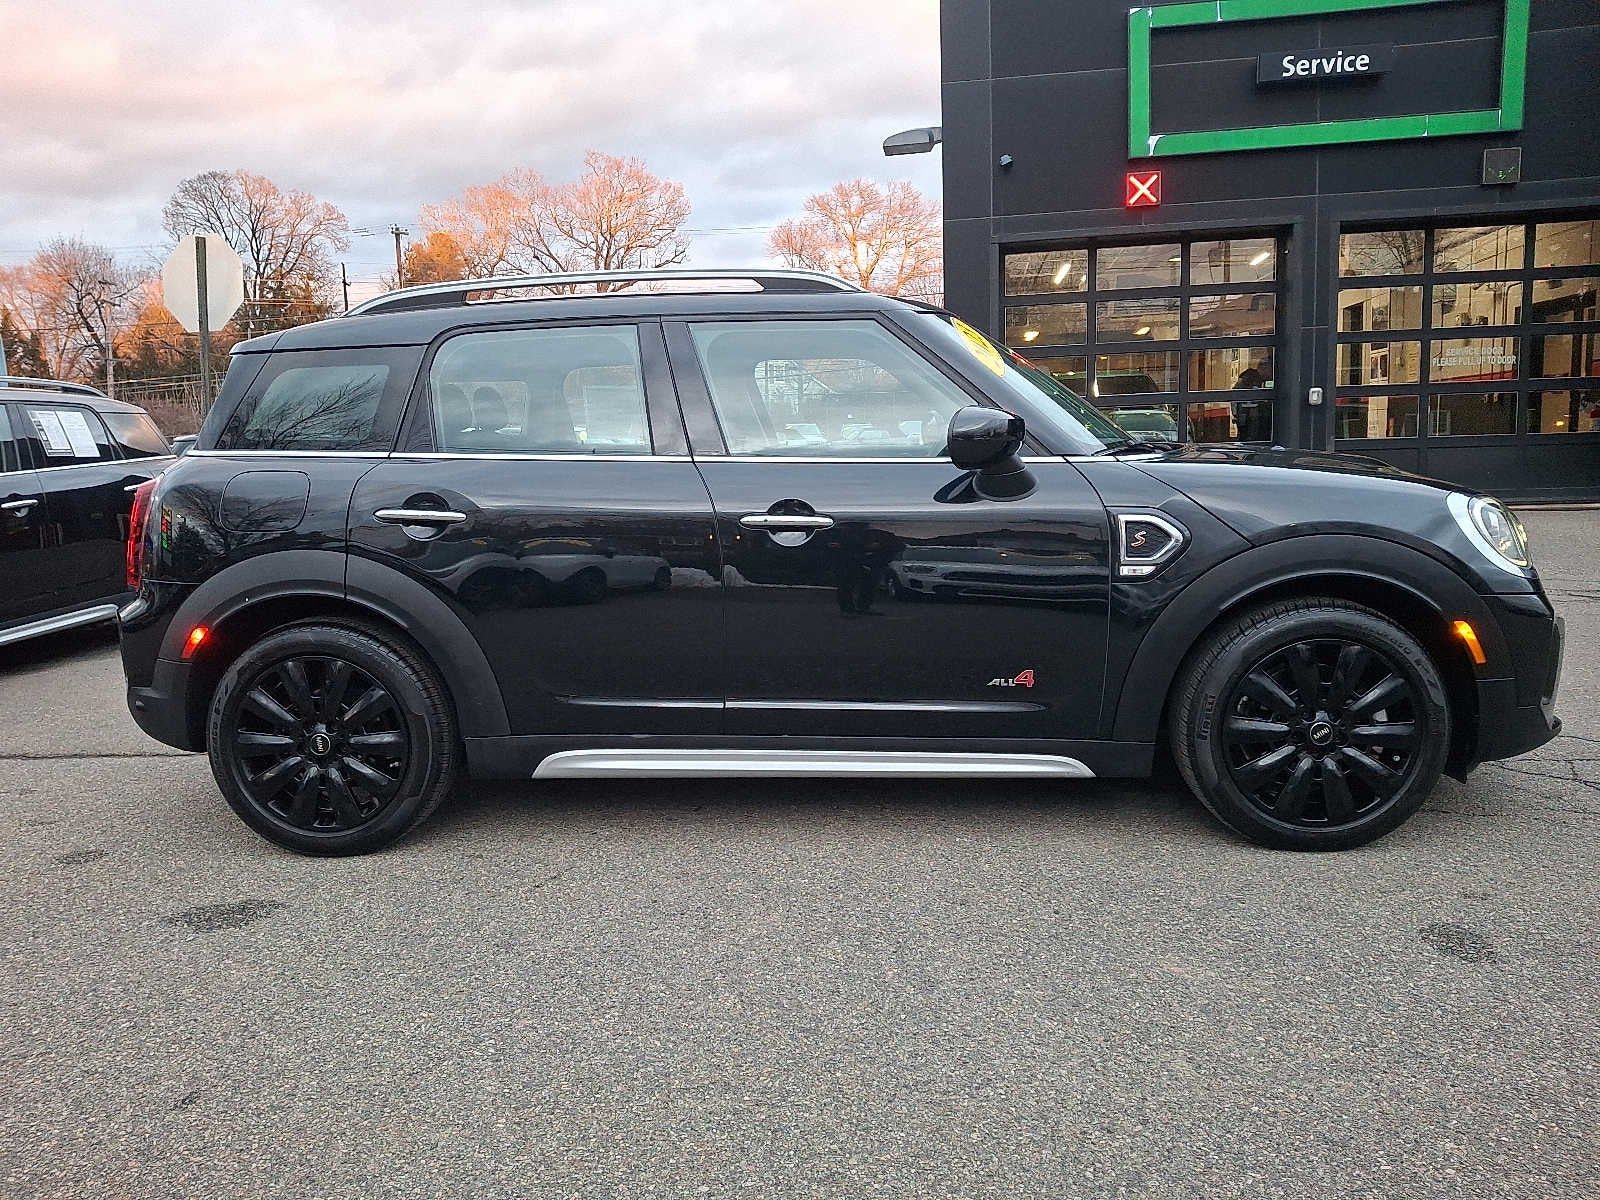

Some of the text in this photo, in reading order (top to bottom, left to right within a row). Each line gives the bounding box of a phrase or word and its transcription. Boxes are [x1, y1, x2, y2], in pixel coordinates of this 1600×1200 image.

[1282, 50, 1370, 77] Service
[1447, 347, 1504, 357] SERVICE DOOR
[1433, 355, 1517, 367] PLEASE PULL UP TO DOOR
[1131, 531, 1147, 548] S
[1312, 726, 1330, 740] MINI
